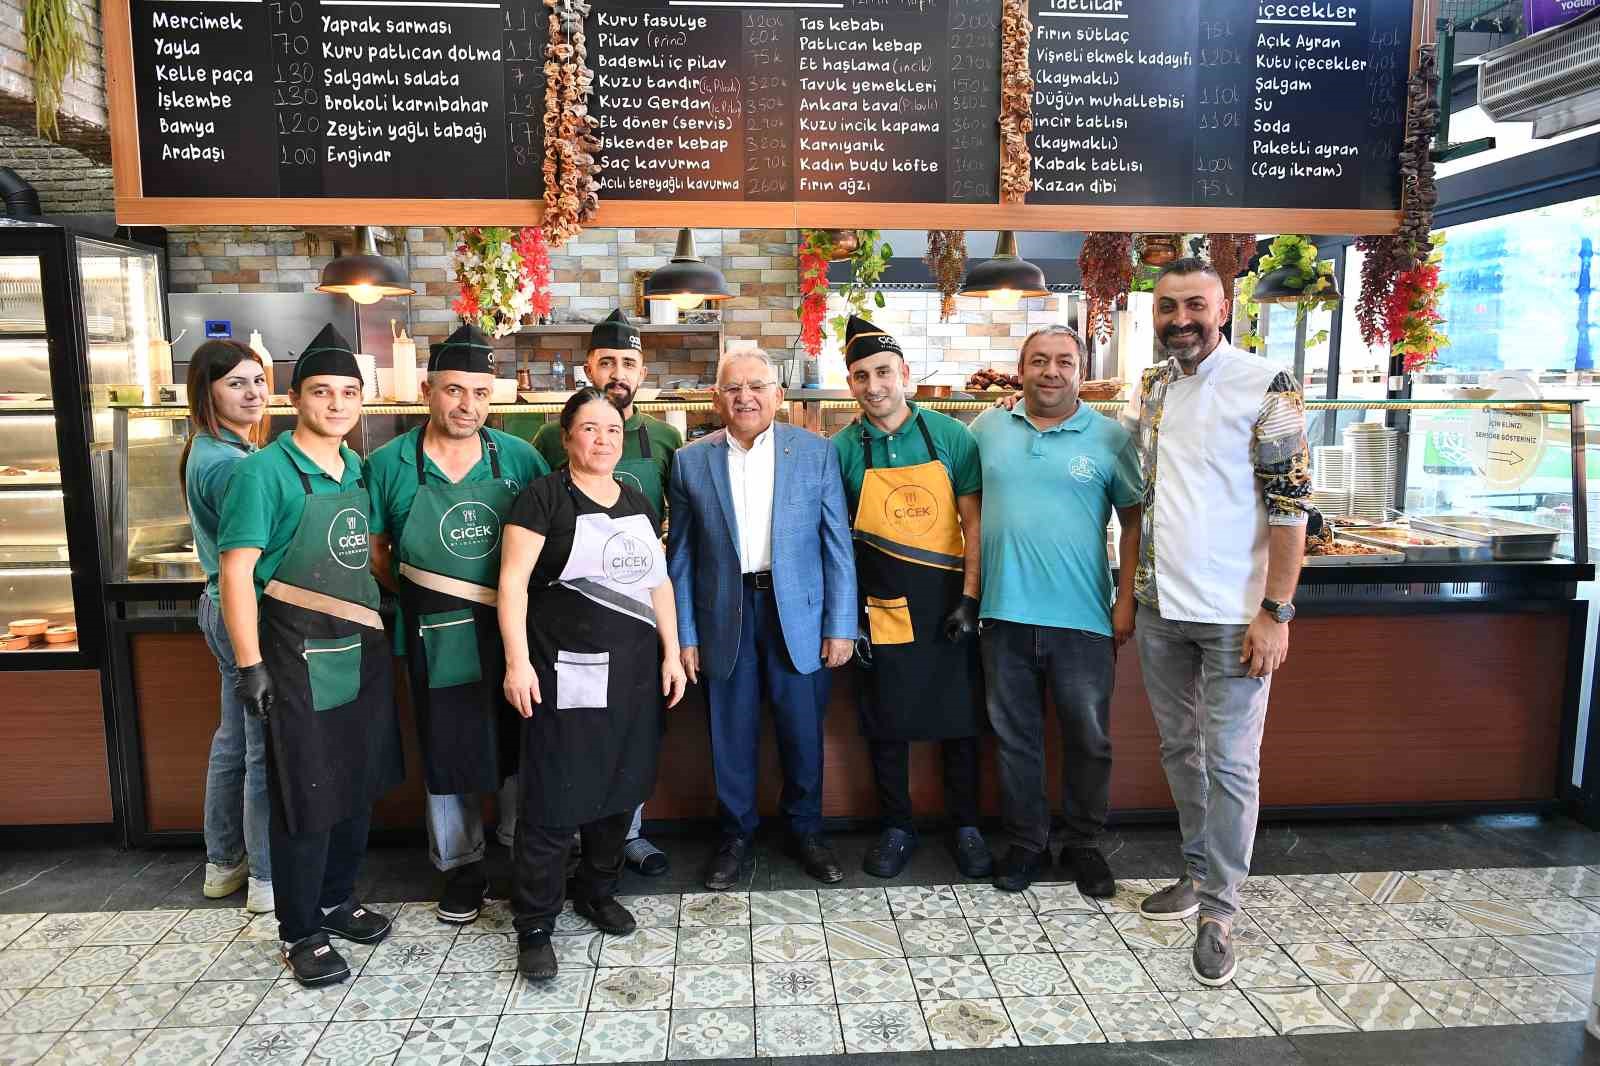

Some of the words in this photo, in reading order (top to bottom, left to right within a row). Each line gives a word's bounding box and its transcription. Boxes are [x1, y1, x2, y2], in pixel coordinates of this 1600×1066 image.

[152, 11, 243, 30] Mercimek
[321, 15, 381, 36] Yaprak
[386, 19, 452, 35] sarması
[597, 13, 637, 28] Kuru
[643, 14, 708, 31] fasulye
[800, 17, 824, 31] Tas
[829, 17, 884, 32] kebabı
[598, 32, 640, 47] Pilav
[1036, 26, 1072, 40] Fırın
[1076, 26, 1130, 44] sütlaç
[1257, 33, 1291, 49] Açık
[1296, 34, 1341, 50] Ayran
[154, 38, 200, 59] Yayla
[321, 42, 363, 59] Kuru
[368, 43, 443, 62] patlıcan
[448, 45, 501, 62] dolma
[800, 37, 868, 51] Patlıcan
[872, 38, 922, 55] kebap
[599, 54, 664, 69] Bademli
[668, 54, 682, 70] iç
[687, 56, 727, 71] pilav
[800, 57, 818, 70] Et
[823, 57, 890, 74] haşlama
[1036, 47, 1083, 64] Vişneli
[1086, 50, 1134, 65] ekmek
[1138, 50, 1192, 68] kadayıfı
[1256, 55, 1291, 69] Kutu
[155, 64, 207, 82] Kelle
[211, 68, 253, 85] paça
[323, 68, 399, 90] Şalgamlı
[403, 71, 459, 86] salata
[599, 74, 642, 89] Kuzu
[647, 76, 700, 90] tandır
[1036, 69, 1119, 88] (kaymaklı)
[800, 78, 847, 91] Tavuk
[852, 79, 937, 94] yemekleri
[1255, 77, 1312, 95] Şalgam
[157, 86, 232, 111] İşkembe
[325, 94, 388, 111] Brokoli
[392, 94, 489, 113] karnıbahar
[599, 95, 642, 108] Kuzu
[647, 95, 711, 109] Gerdan
[800, 98, 858, 112] Ankara
[862, 99, 898, 112] tava
[1035, 90, 1085, 111] Düğün
[1089, 94, 1184, 109] muhallebisi
[1254, 98, 1273, 112] Su
[159, 117, 215, 138] Bamya
[599, 115, 618, 129] Et
[622, 116, 668, 130] döner
[673, 116, 733, 130] (servis)
[800, 118, 837, 130] Kuzu
[841, 118, 877, 132] incik
[881, 118, 940, 134] kapama
[1076, 114, 1128, 129] tatlısı
[1253, 119, 1291, 135] Soda
[326, 119, 382, 140] Zeytin
[388, 121, 429, 143] yağlı
[433, 122, 487, 144] tabağı
[600, 132, 674, 149] İskender
[678, 135, 729, 152] kebap
[800, 138, 885, 154] Karnıyarık
[1034, 134, 1118, 152] (kaymaklı)
[1253, 140, 1311, 156] Paketli
[1314, 143, 1359, 158] ayran
[162, 143, 225, 162] Arabaşı
[327, 146, 391, 168] Enginar
[600, 155, 629, 170] Saç
[635, 156, 710, 170] kavurma
[800, 158, 845, 171] Kadın
[849, 159, 888, 172] budu
[892, 158, 939, 173] köfte
[1034, 156, 1086, 171] Kabak
[1091, 157, 1143, 172] tatlısı
[1251, 162, 1286, 180] (Çay
[1290, 162, 1343, 178] ikram)
[600, 176, 626, 190] Acılı
[629, 176, 684, 193] tereyağlı
[687, 177, 739, 190] kavurma
[800, 177, 834, 191] Fırın
[838, 177, 871, 195] ağzı
[1034, 178, 1084, 192] Kazan
[1089, 178, 1117, 193] dibi
